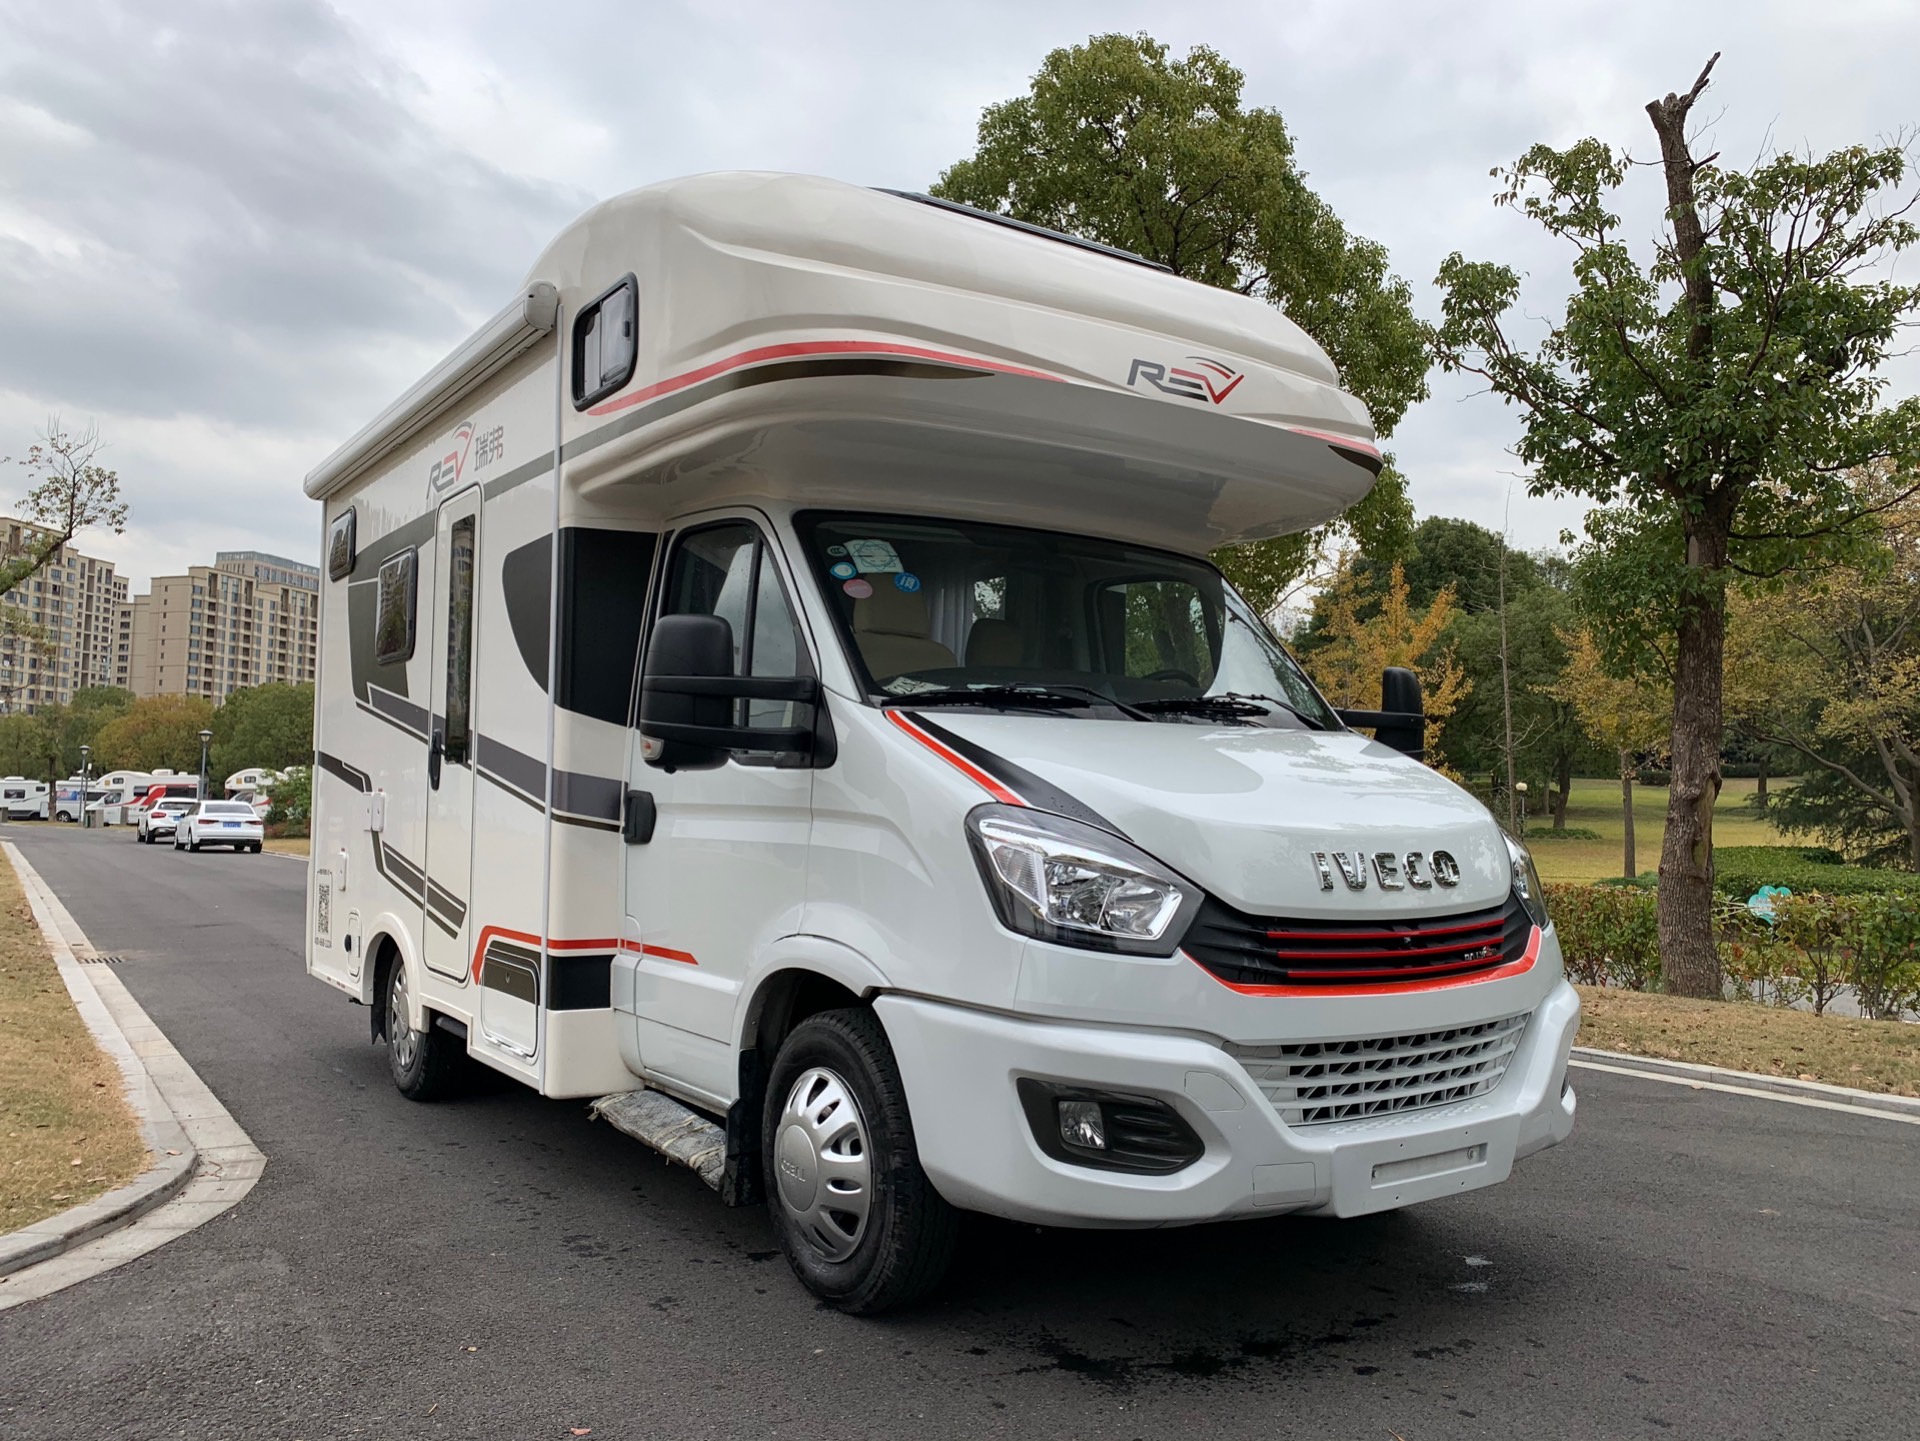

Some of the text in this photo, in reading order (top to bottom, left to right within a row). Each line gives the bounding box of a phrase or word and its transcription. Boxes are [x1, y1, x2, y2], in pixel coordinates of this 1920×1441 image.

[1127, 357, 1245, 405] REV
[426, 422, 477, 500] REV
[1311, 850, 1461, 892] IVECO
